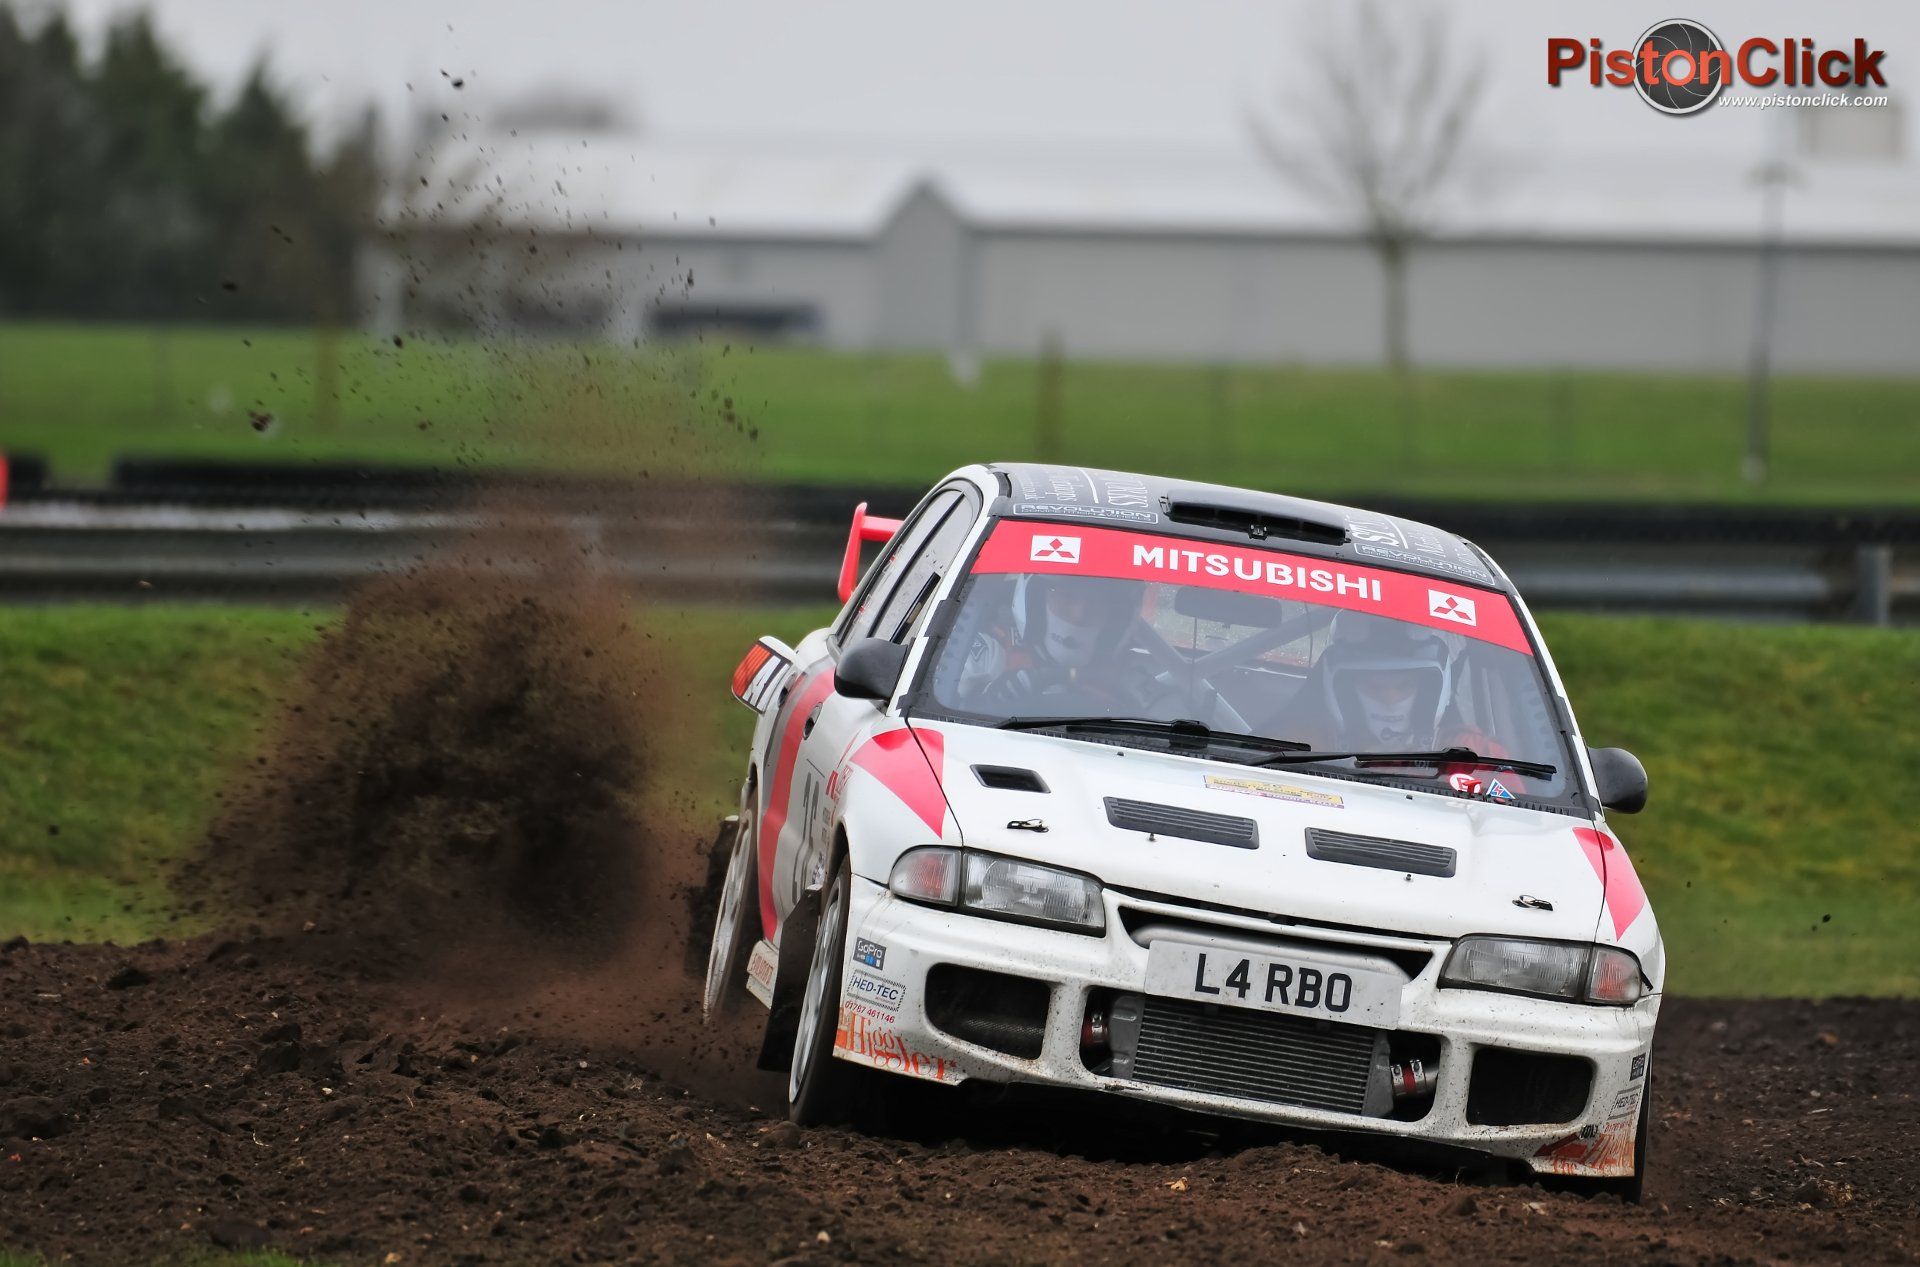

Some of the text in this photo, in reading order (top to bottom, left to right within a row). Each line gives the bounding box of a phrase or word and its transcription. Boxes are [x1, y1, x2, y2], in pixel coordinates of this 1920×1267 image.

[1133, 544, 1382, 601] MITSUBISHI
[857, 940, 883, 959] GoPro
[852, 976, 899, 1001] HED-TEC
[1194, 953, 1353, 1013] L4 RBO
[867, 1008, 895, 1024] 461146
